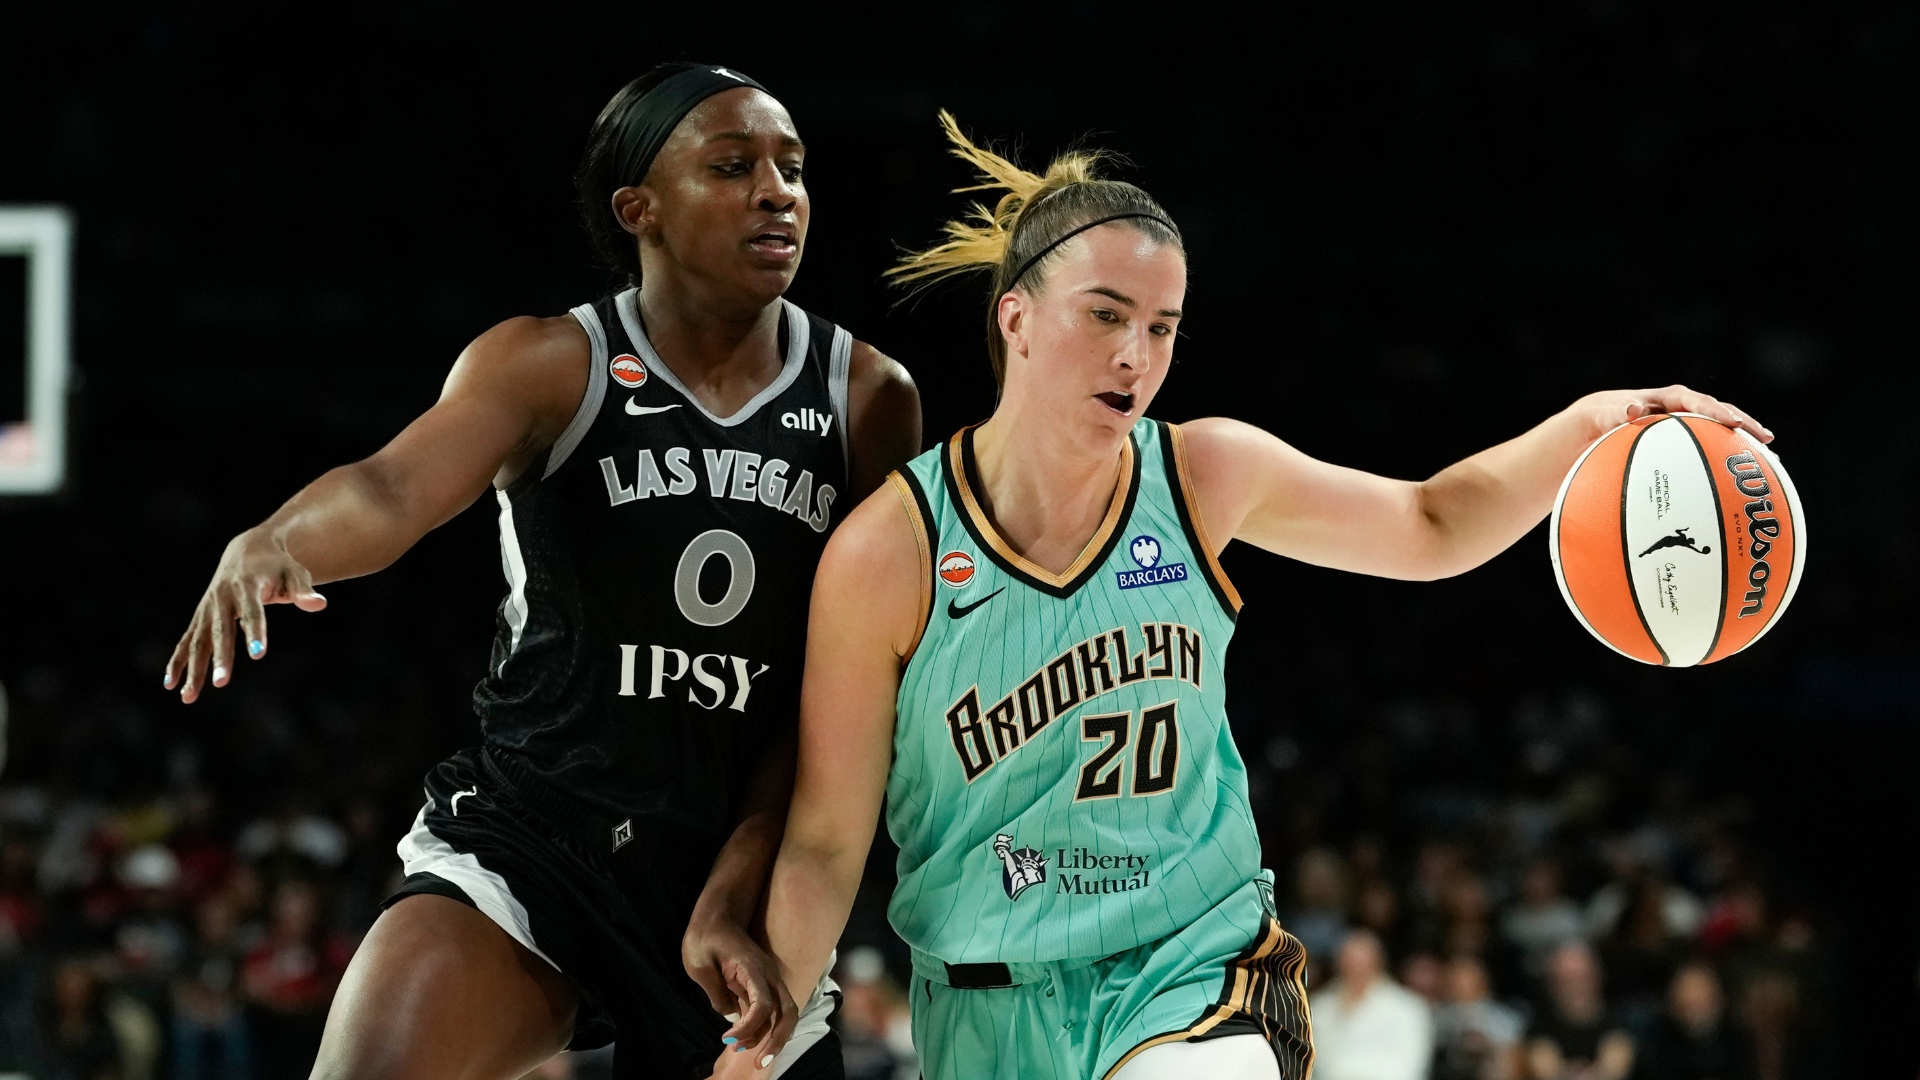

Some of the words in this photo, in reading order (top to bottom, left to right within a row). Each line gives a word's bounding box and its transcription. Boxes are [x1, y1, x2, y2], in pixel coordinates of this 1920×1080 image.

[781, 408, 832, 436] ally
[599, 447, 697, 507] LAS
[702, 449, 837, 533] VEGAS
[1654, 469, 1662, 495] GAME
[1662, 473, 1671, 514] OFFICIAL
[1656, 496, 1664, 521] BALL
[1734, 513, 1742, 533] EVO
[1725, 449, 1780, 619] Wilson
[674, 529, 756, 626] 0
[1119, 565, 1185, 587] BARCLAYS
[617, 644, 770, 713] IPSY
[944, 621, 1202, 785] BROOKLYN
[1073, 699, 1180, 803] 20
[1056, 848, 1150, 875] Liberty
[1056, 871, 1150, 895] Mutual
